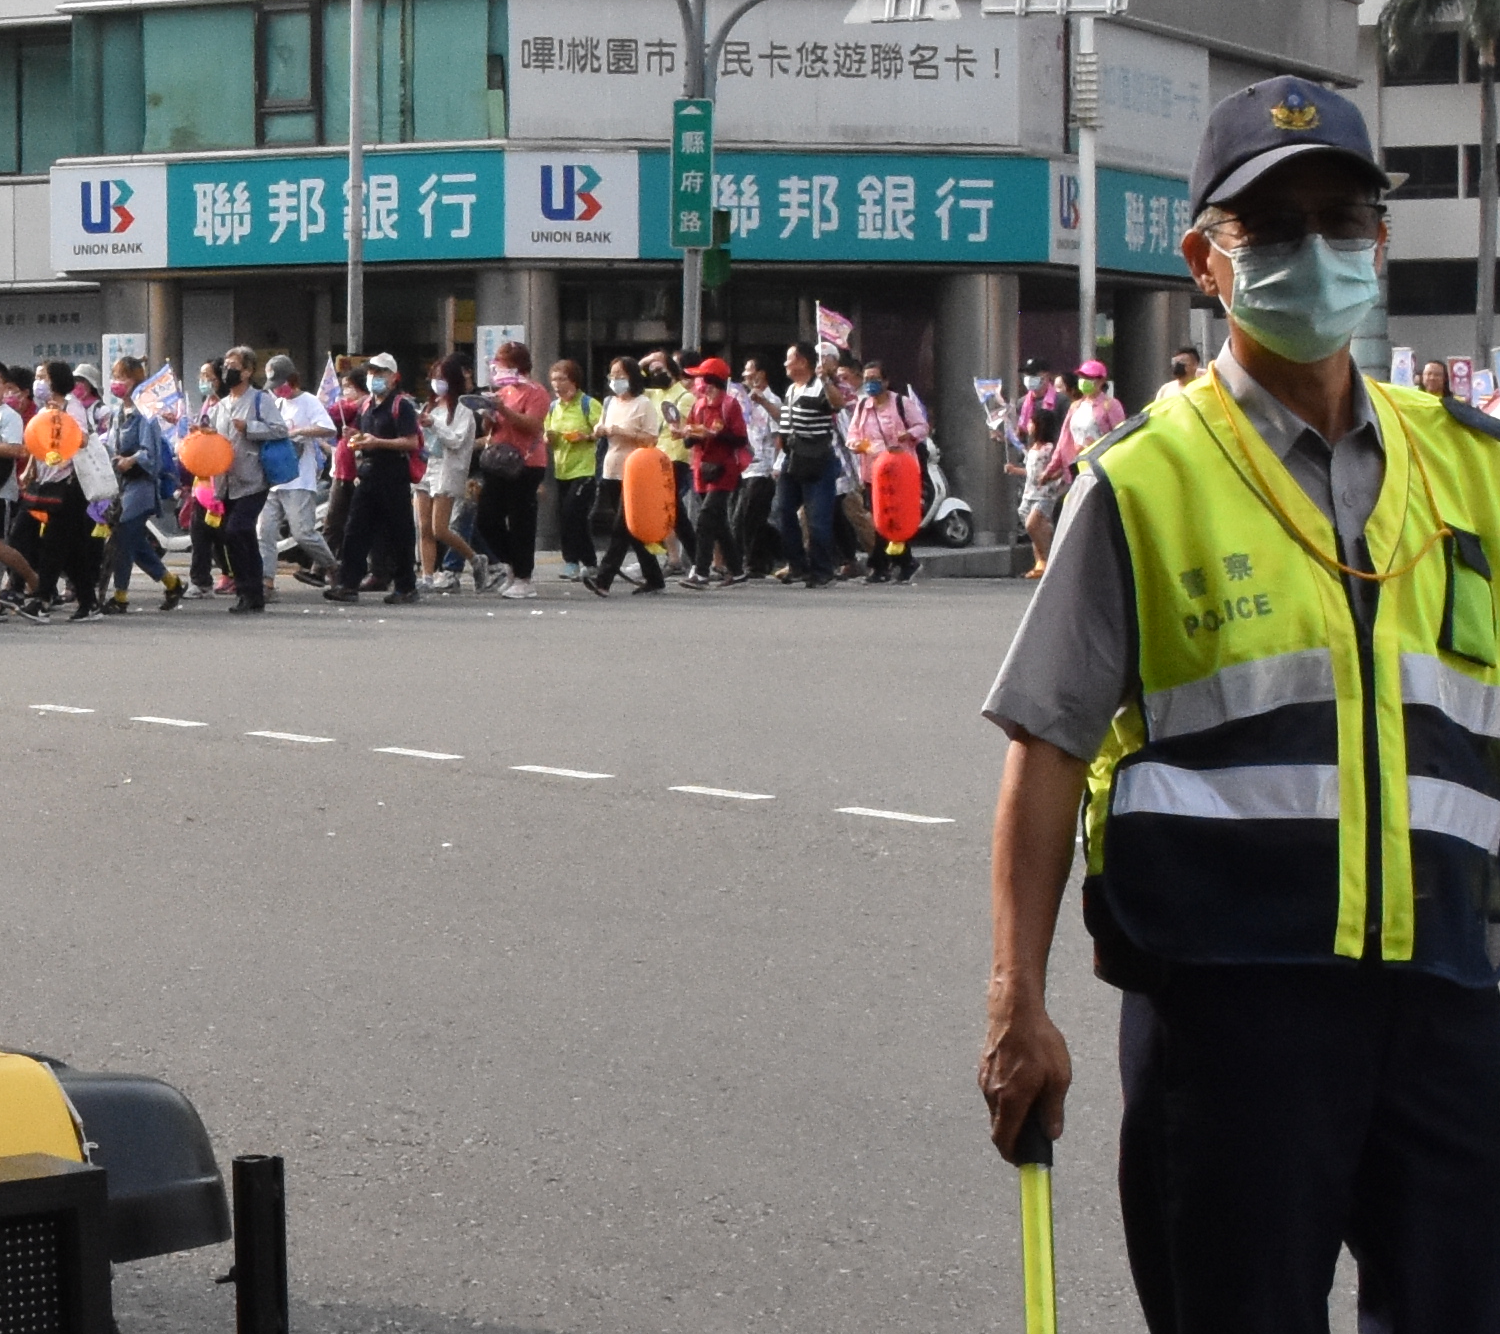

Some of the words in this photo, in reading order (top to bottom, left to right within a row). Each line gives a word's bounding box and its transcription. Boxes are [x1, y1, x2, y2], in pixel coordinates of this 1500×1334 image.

[194, 172, 478, 247] 聯邦銀行
[680, 130, 705, 238] 縣府路
[712, 175, 996, 243] 聯邦銀行
[73, 244, 109, 256] UNION
[111, 242, 143, 255] BANK
[530, 230, 572, 244] UNION
[575, 230, 612, 244] BANK
[1183, 593, 1273, 640] POLICE
